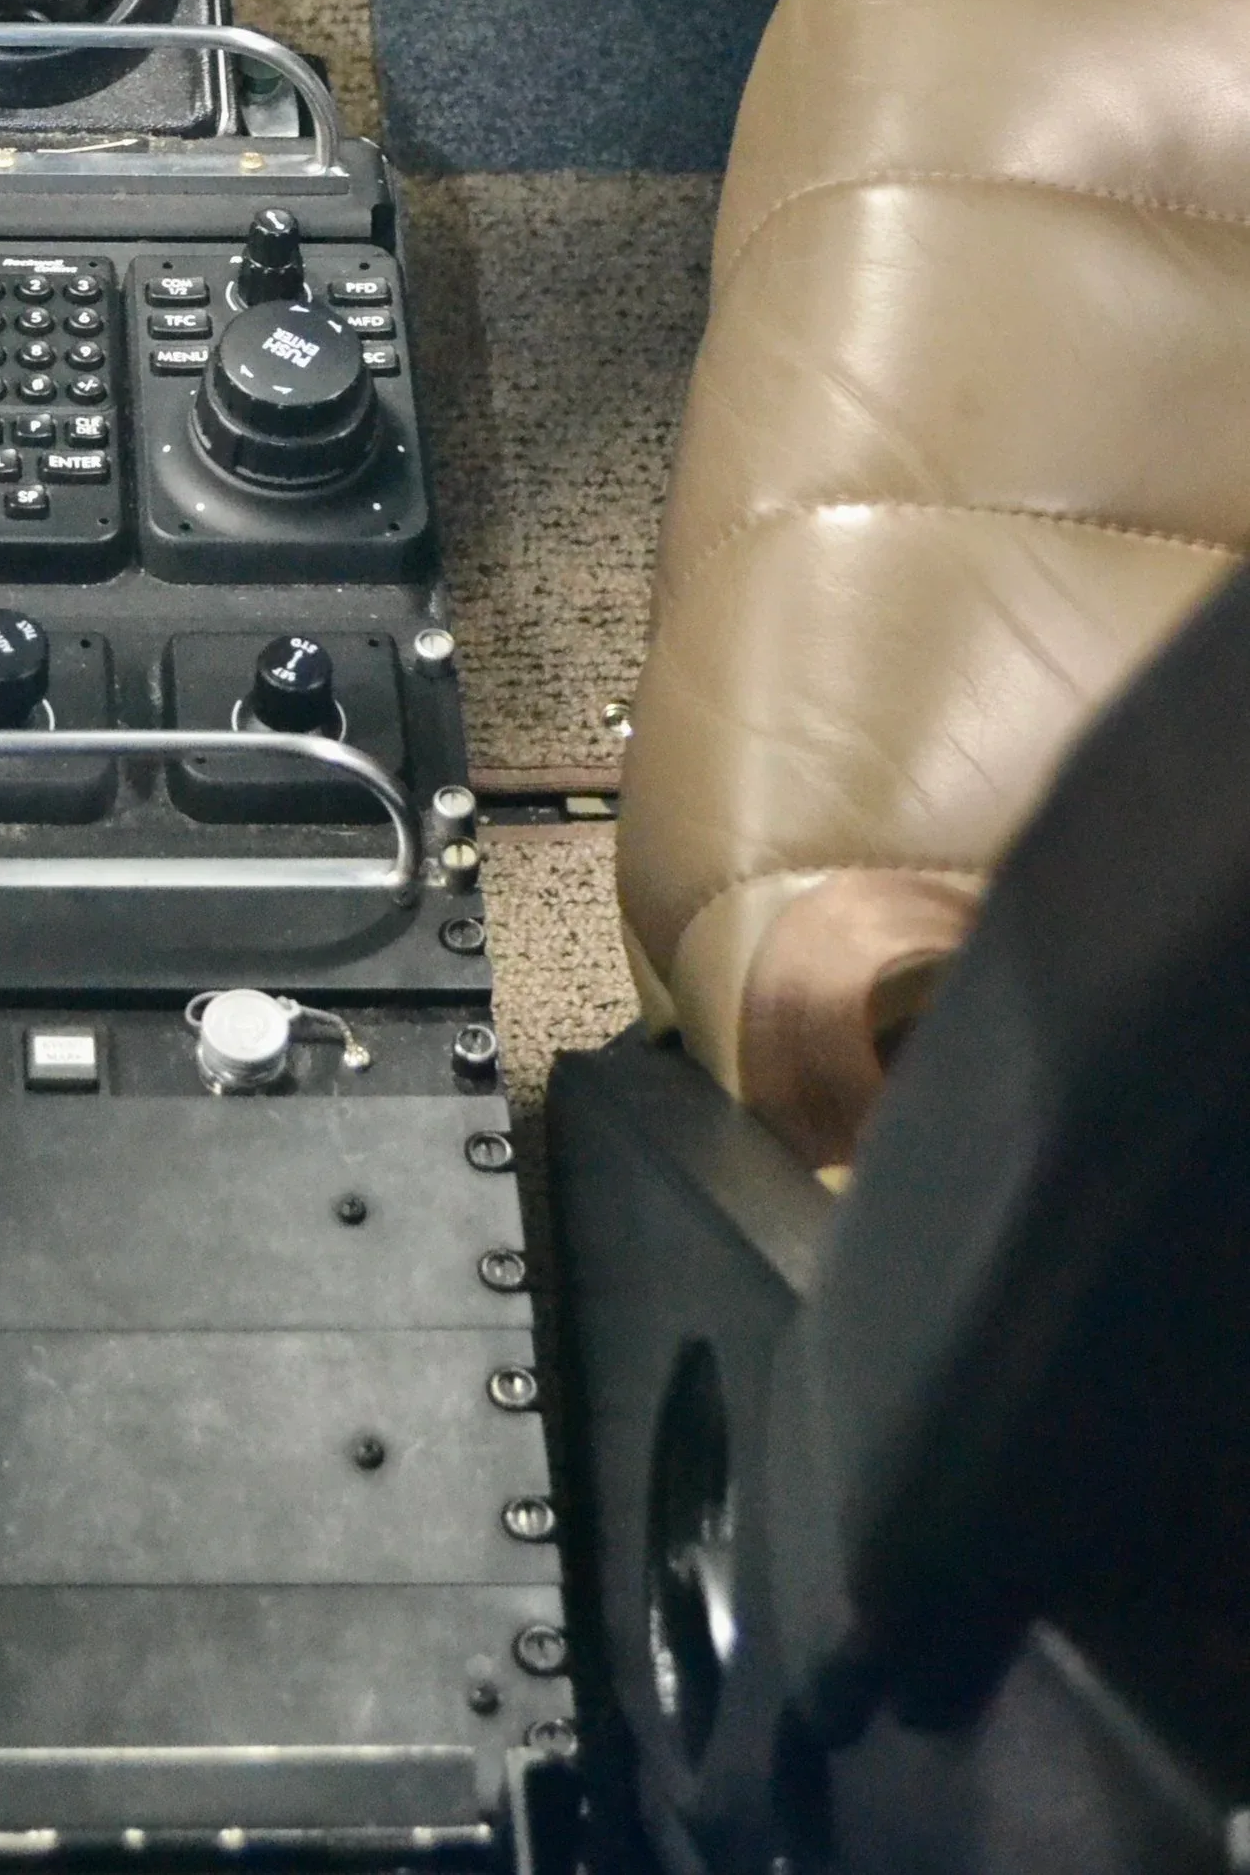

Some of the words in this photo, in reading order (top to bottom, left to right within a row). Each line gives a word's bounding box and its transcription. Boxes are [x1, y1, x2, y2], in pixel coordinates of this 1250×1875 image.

[346, 282, 377, 293] PFD
[165, 315, 196, 326] TFC
[158, 352, 208, 362] MENU
[50, 456, 102, 468] ENTER
